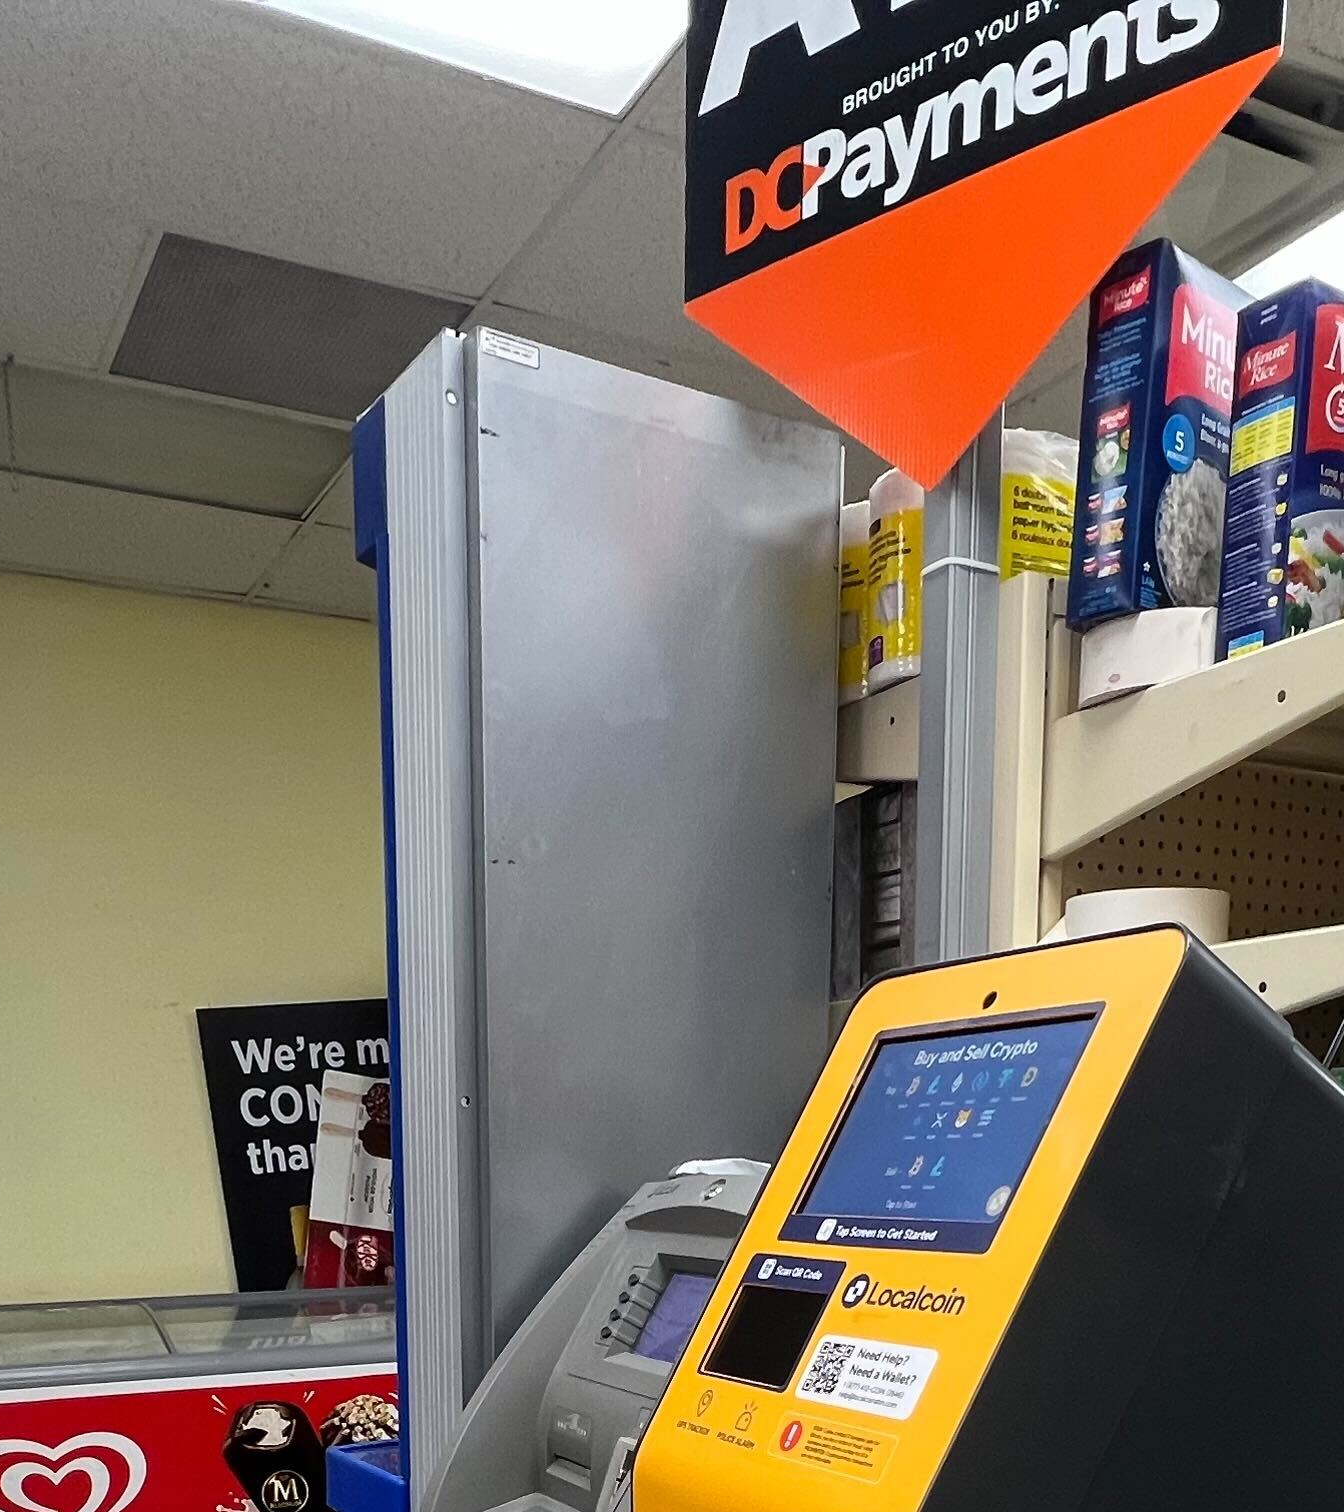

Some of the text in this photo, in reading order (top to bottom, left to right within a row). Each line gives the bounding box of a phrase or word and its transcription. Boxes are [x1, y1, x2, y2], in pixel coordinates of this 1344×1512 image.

[843, 55, 936, 115] BROUGHT
[941, 41, 970, 68] TO
[974, 14, 1022, 52] YOU
[1181, 304, 1235, 370] Minu
[1204, 360, 1232, 400] Ric
[1174, 432, 1185, 453] 5
[231, 1035, 346, 1075] We're
[913, 1038, 1039, 1067] Buy and Sell Crypto
[836, 1226, 938, 1242] Tap Screen to Get Started
[775, 1265, 823, 1281] Scan QR Code
[865, 1281, 966, 1316] Localcoin
[857, 1347, 911, 1367] Need Help?
[849, 1364, 918, 1387] Need a Wallet?
